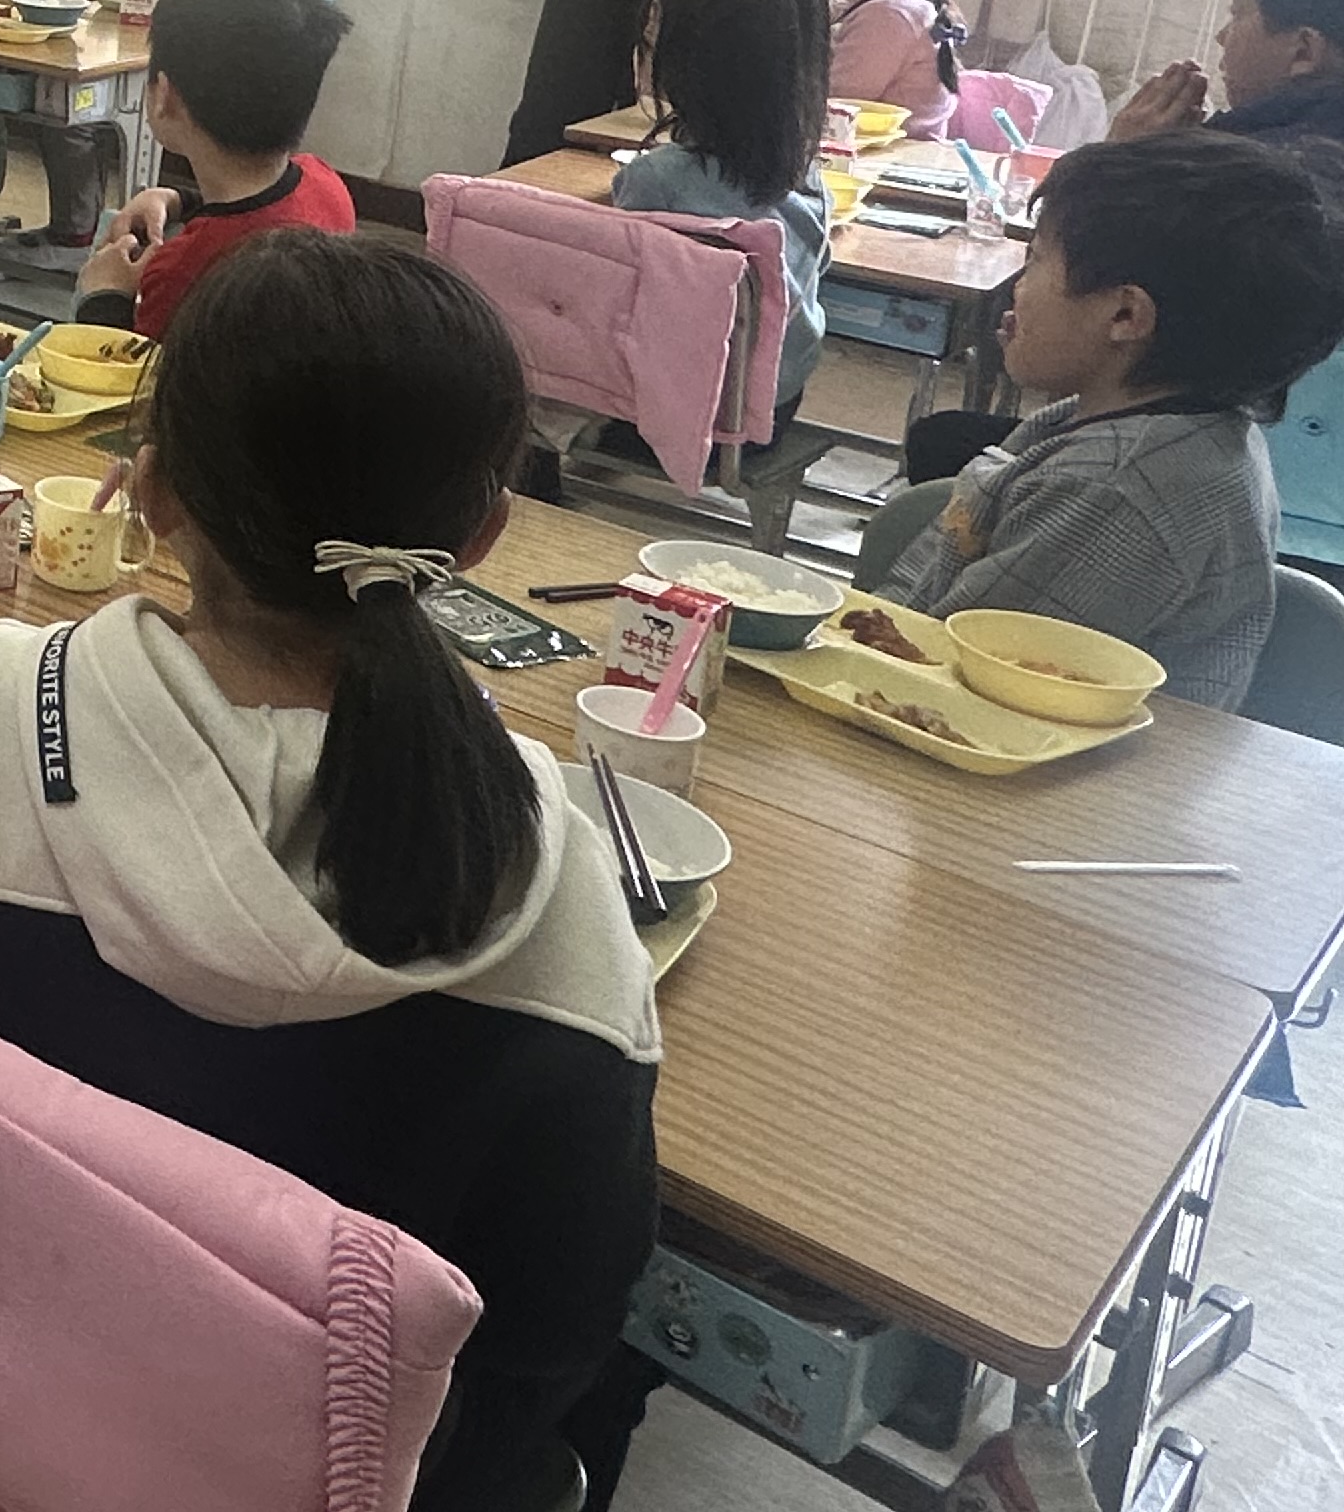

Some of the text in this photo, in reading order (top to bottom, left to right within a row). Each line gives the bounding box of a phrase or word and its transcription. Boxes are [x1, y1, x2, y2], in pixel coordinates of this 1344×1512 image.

[622, 627, 679, 660] 中央牛
[42, 708, 65, 782] STYLE
